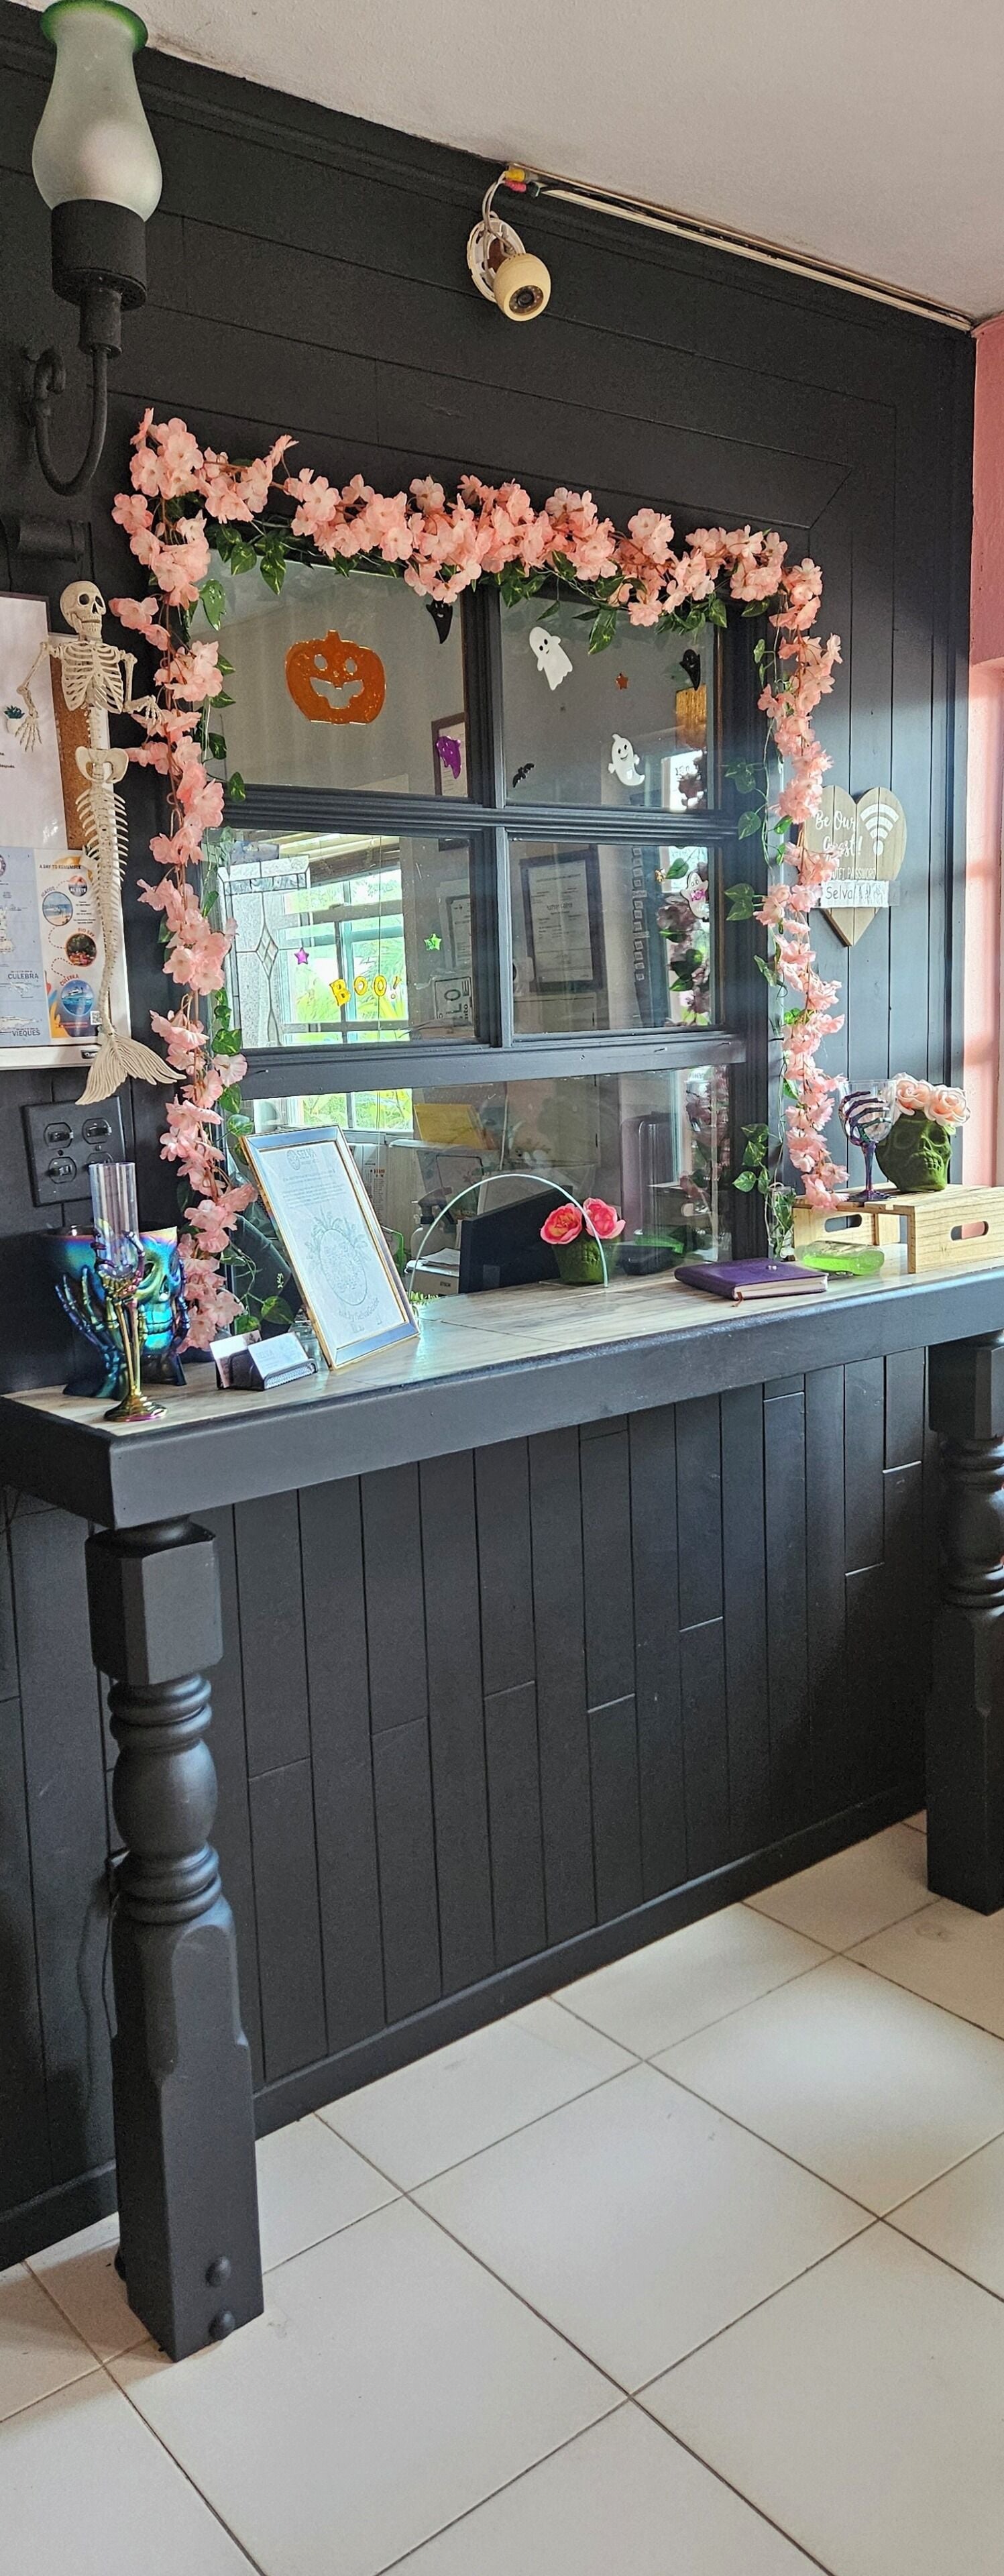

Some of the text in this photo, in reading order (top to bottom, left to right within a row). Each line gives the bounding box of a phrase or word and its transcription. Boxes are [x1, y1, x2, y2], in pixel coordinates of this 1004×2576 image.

[815, 810, 858, 832] Be Our
[822, 833, 863, 857] Gest!
